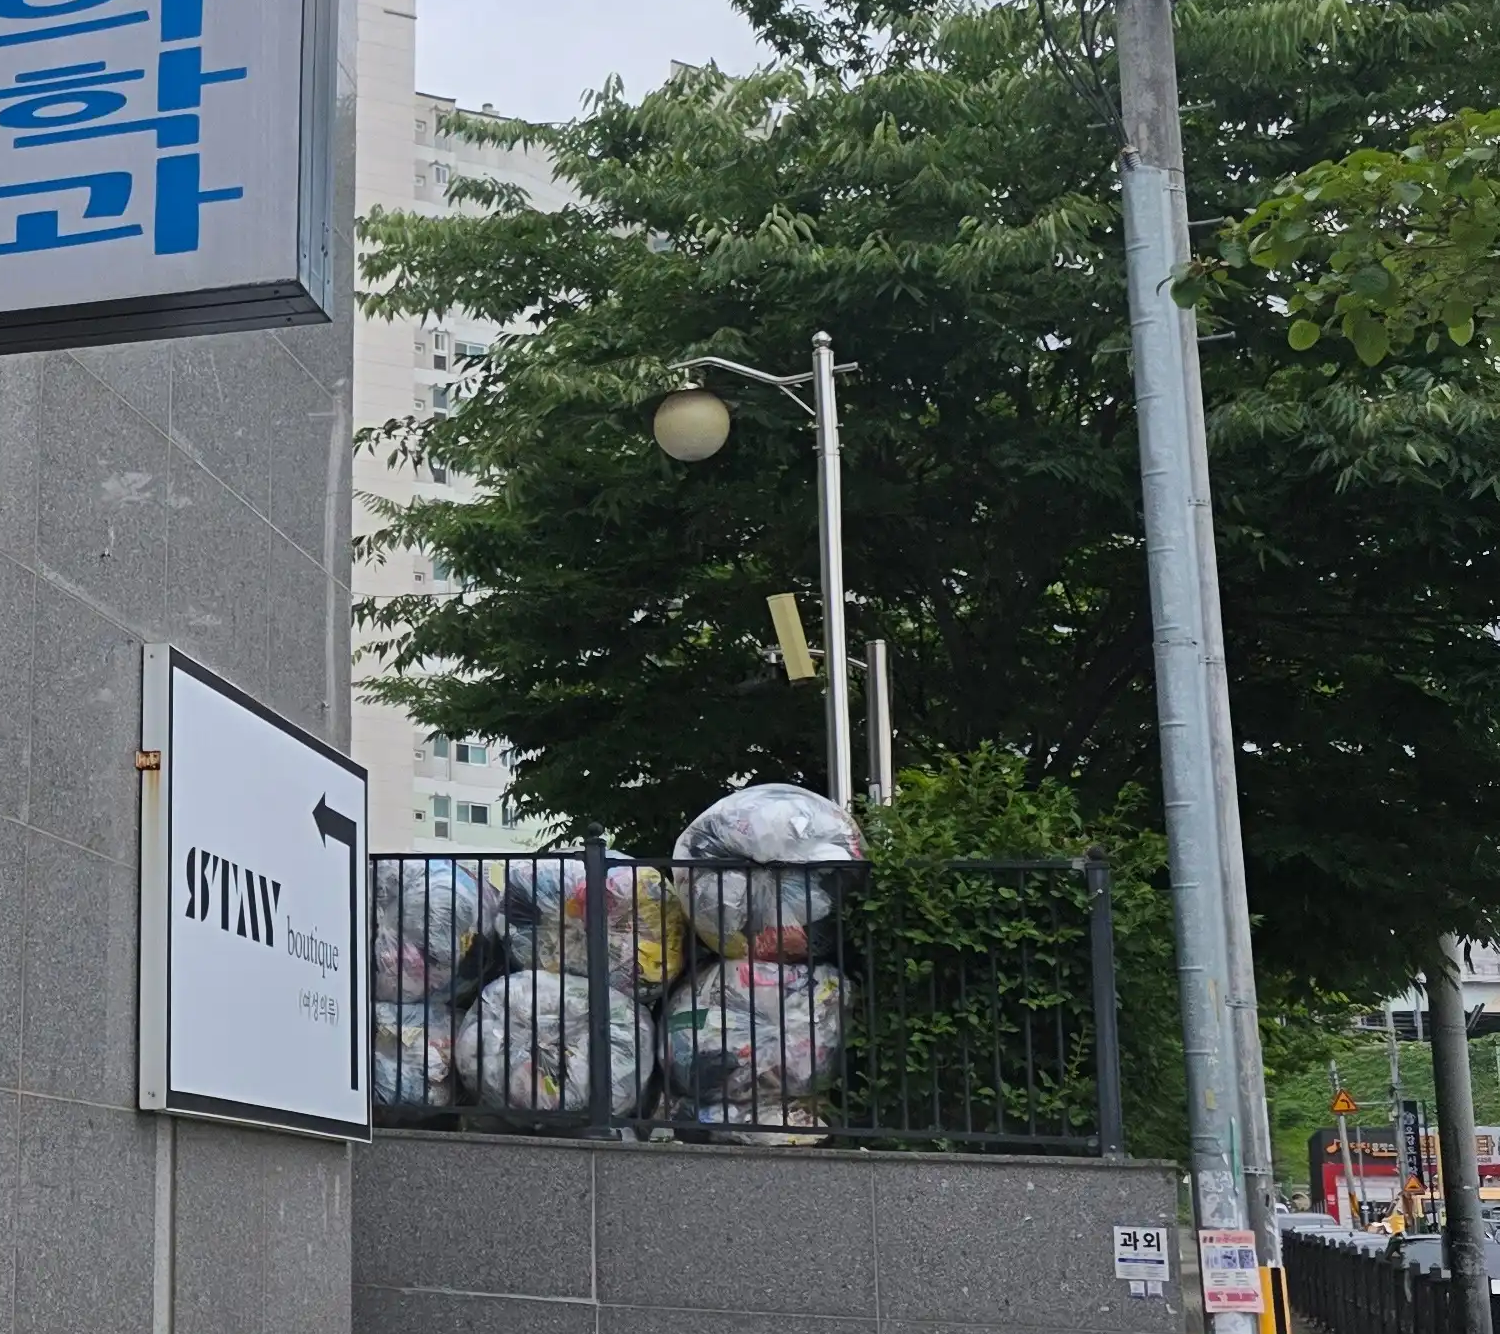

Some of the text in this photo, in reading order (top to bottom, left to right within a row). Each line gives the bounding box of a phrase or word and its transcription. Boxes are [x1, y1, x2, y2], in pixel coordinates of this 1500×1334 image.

[185, 846, 281, 948] STAY
[286, 915, 339, 978] boutique
[1120, 1231, 1161, 1252] 과외
